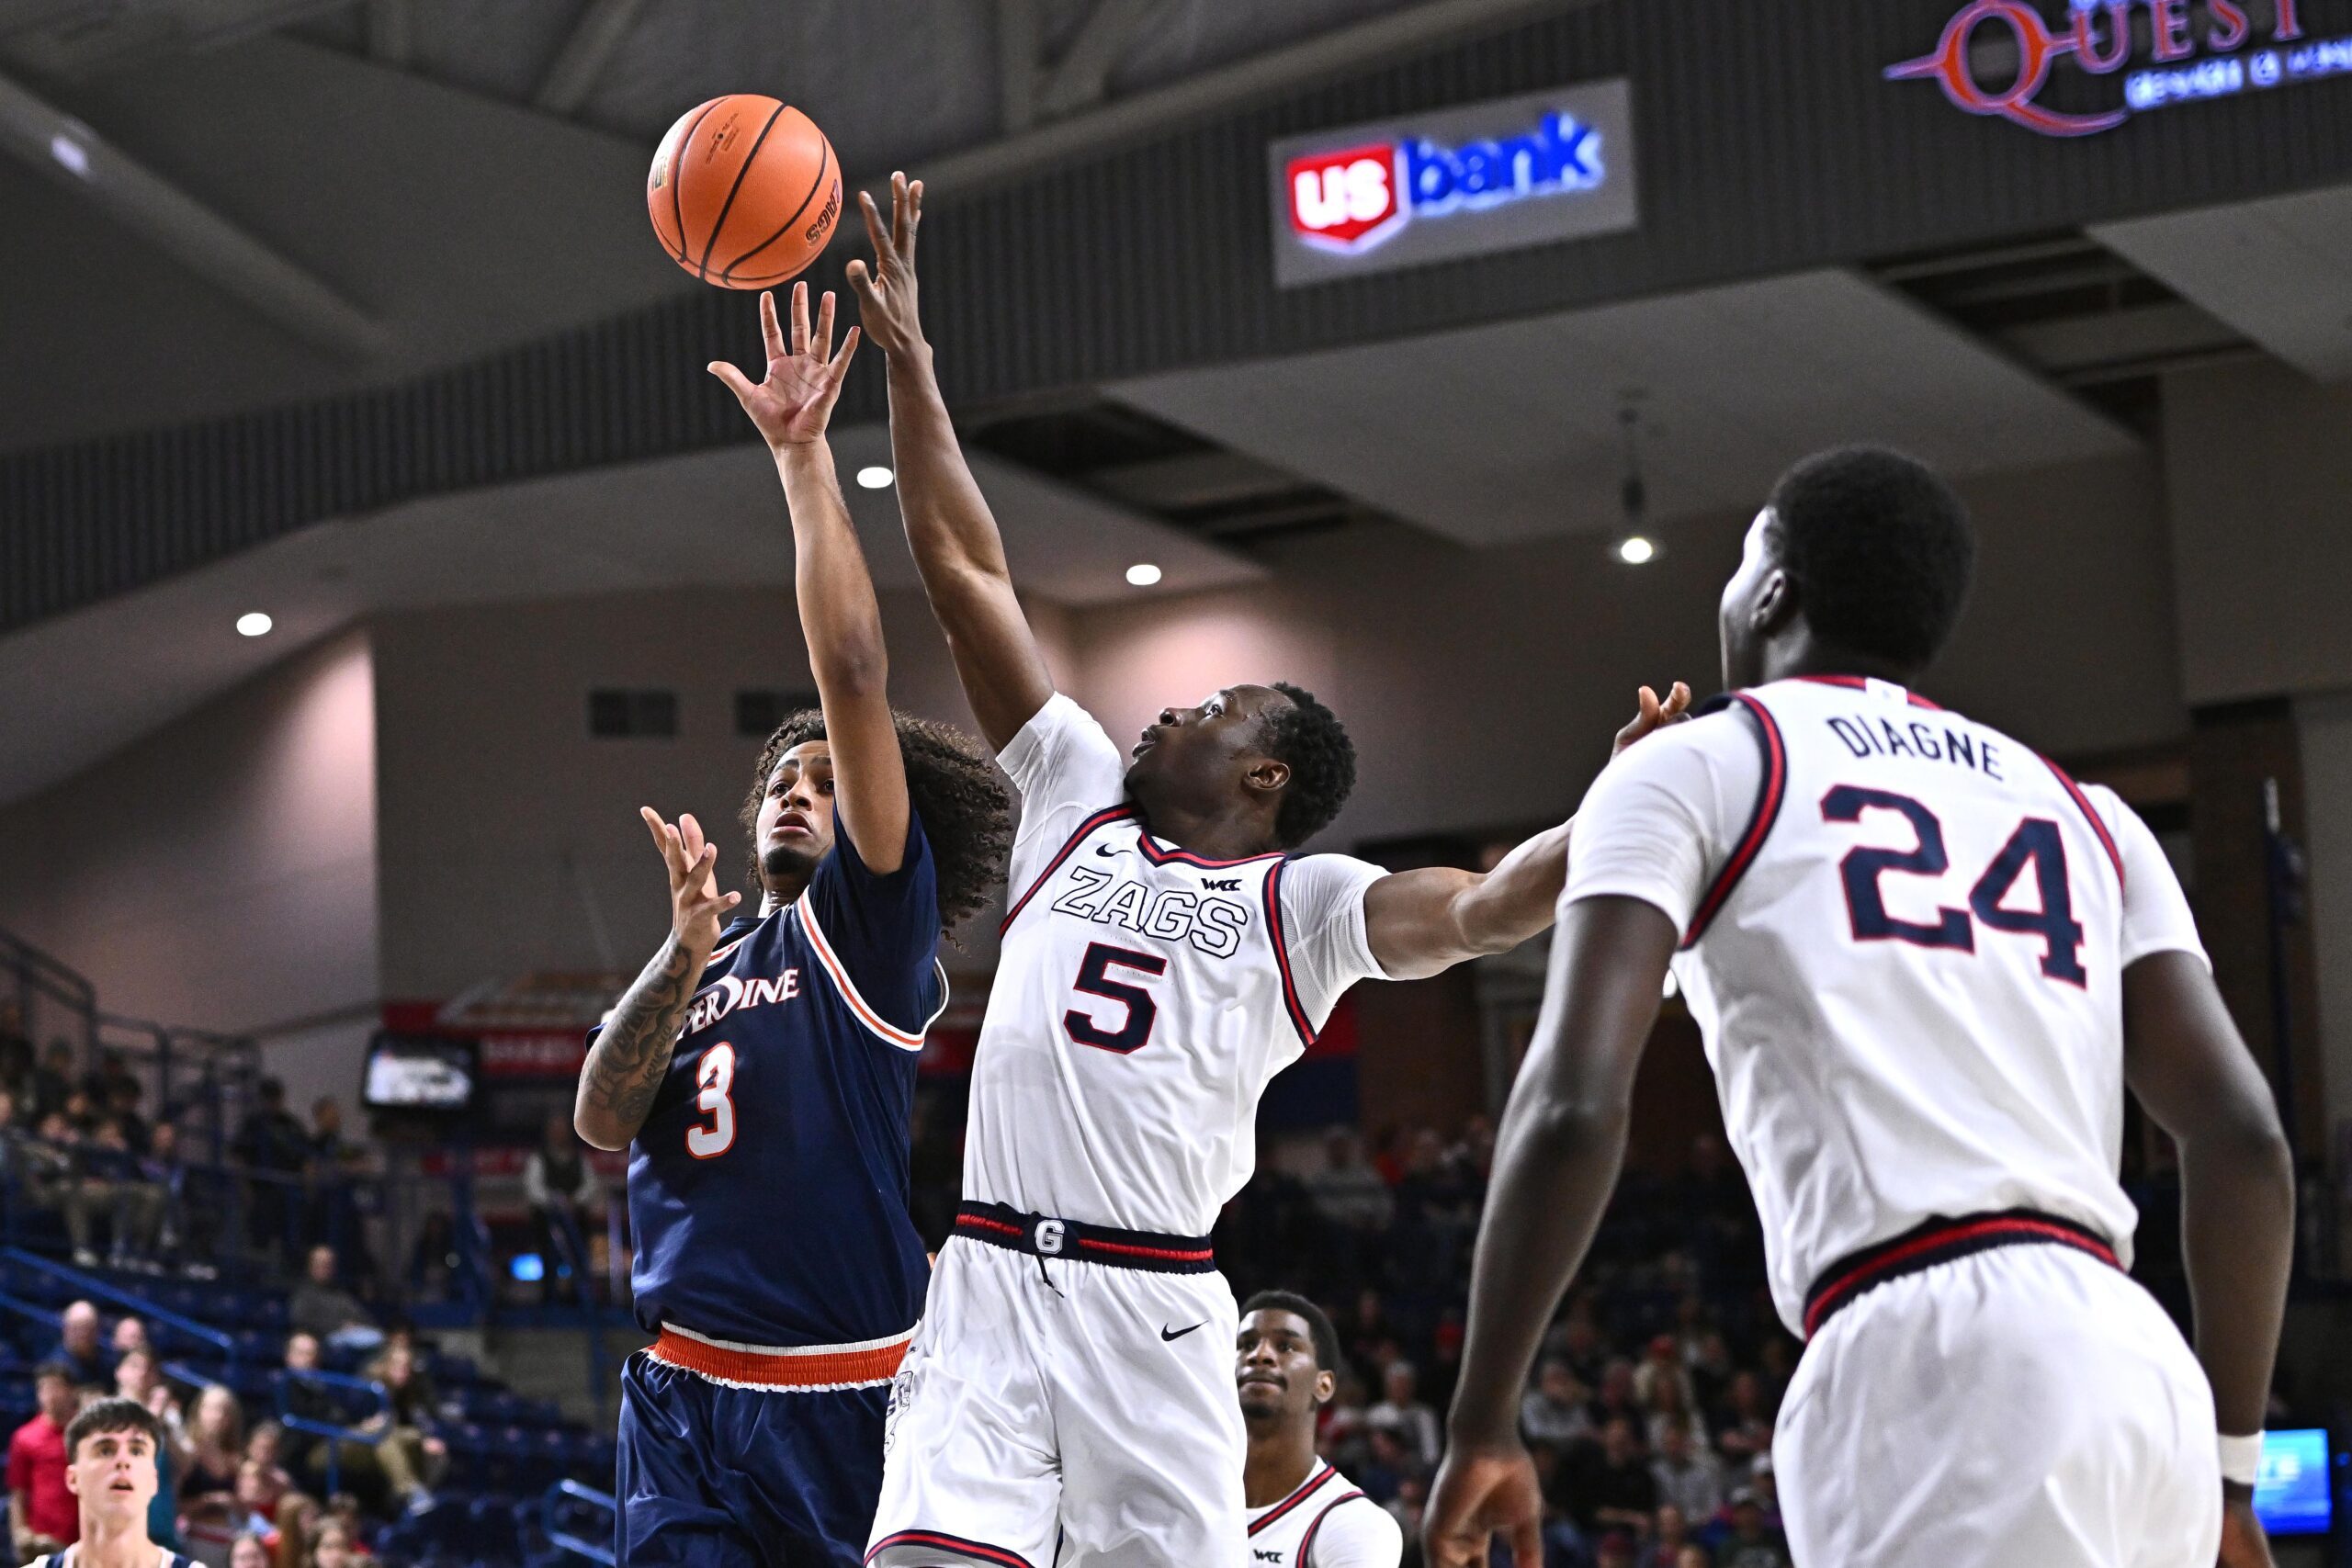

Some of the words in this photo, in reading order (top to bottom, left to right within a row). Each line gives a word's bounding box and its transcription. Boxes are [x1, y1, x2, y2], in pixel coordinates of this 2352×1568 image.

[1399, 111, 1604, 217] bank
[1826, 715, 2003, 782] DIAGNE
[1051, 866, 1248, 959] ZAGS
[1200, 878, 1242, 891] WCC
[1819, 783, 2087, 991] 24
[676, 968, 800, 1041] PERDINE
[1063, 942, 1167, 1055] 5
[685, 1042, 736, 1159] 3
[1035, 1219, 1065, 1254] G
[1253, 1549, 1283, 1563] WCC
